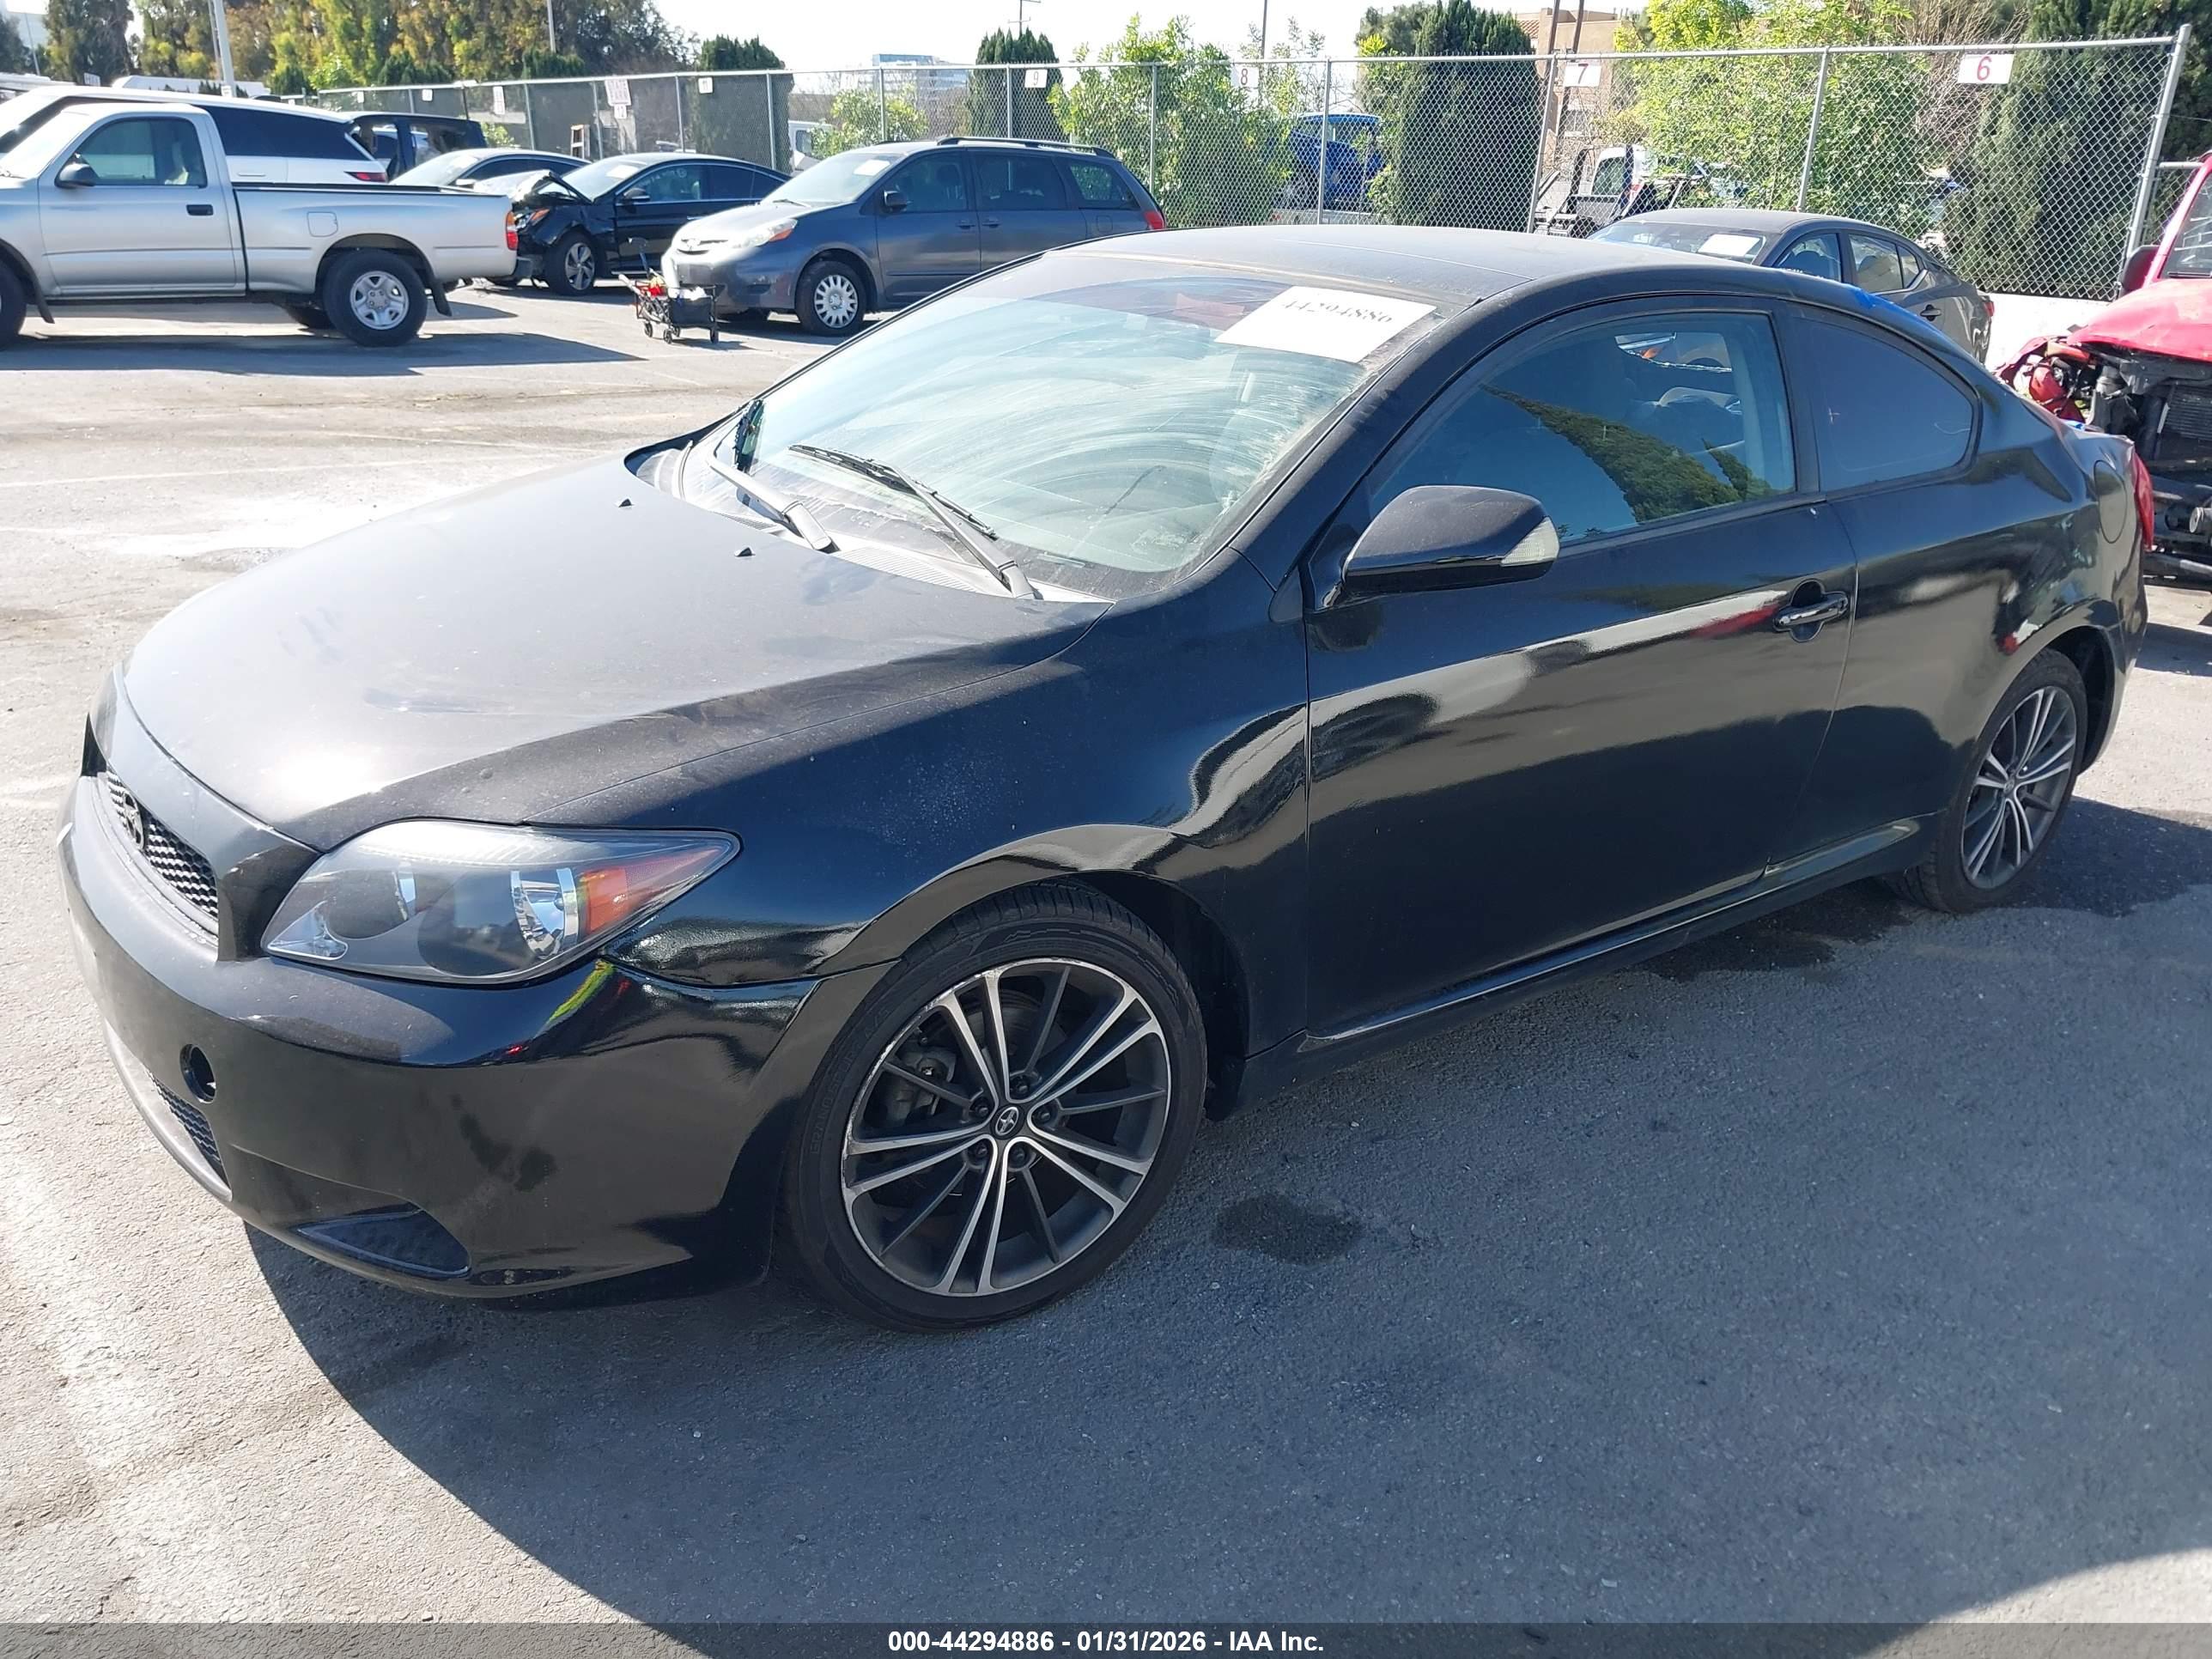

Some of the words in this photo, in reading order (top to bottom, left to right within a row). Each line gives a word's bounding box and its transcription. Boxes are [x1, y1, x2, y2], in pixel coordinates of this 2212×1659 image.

[1241, 68, 1249, 85] 8
[1577, 63, 1589, 84] 7
[1977, 55, 1992, 81] 6
[1033, 70, 1039, 86] 9
